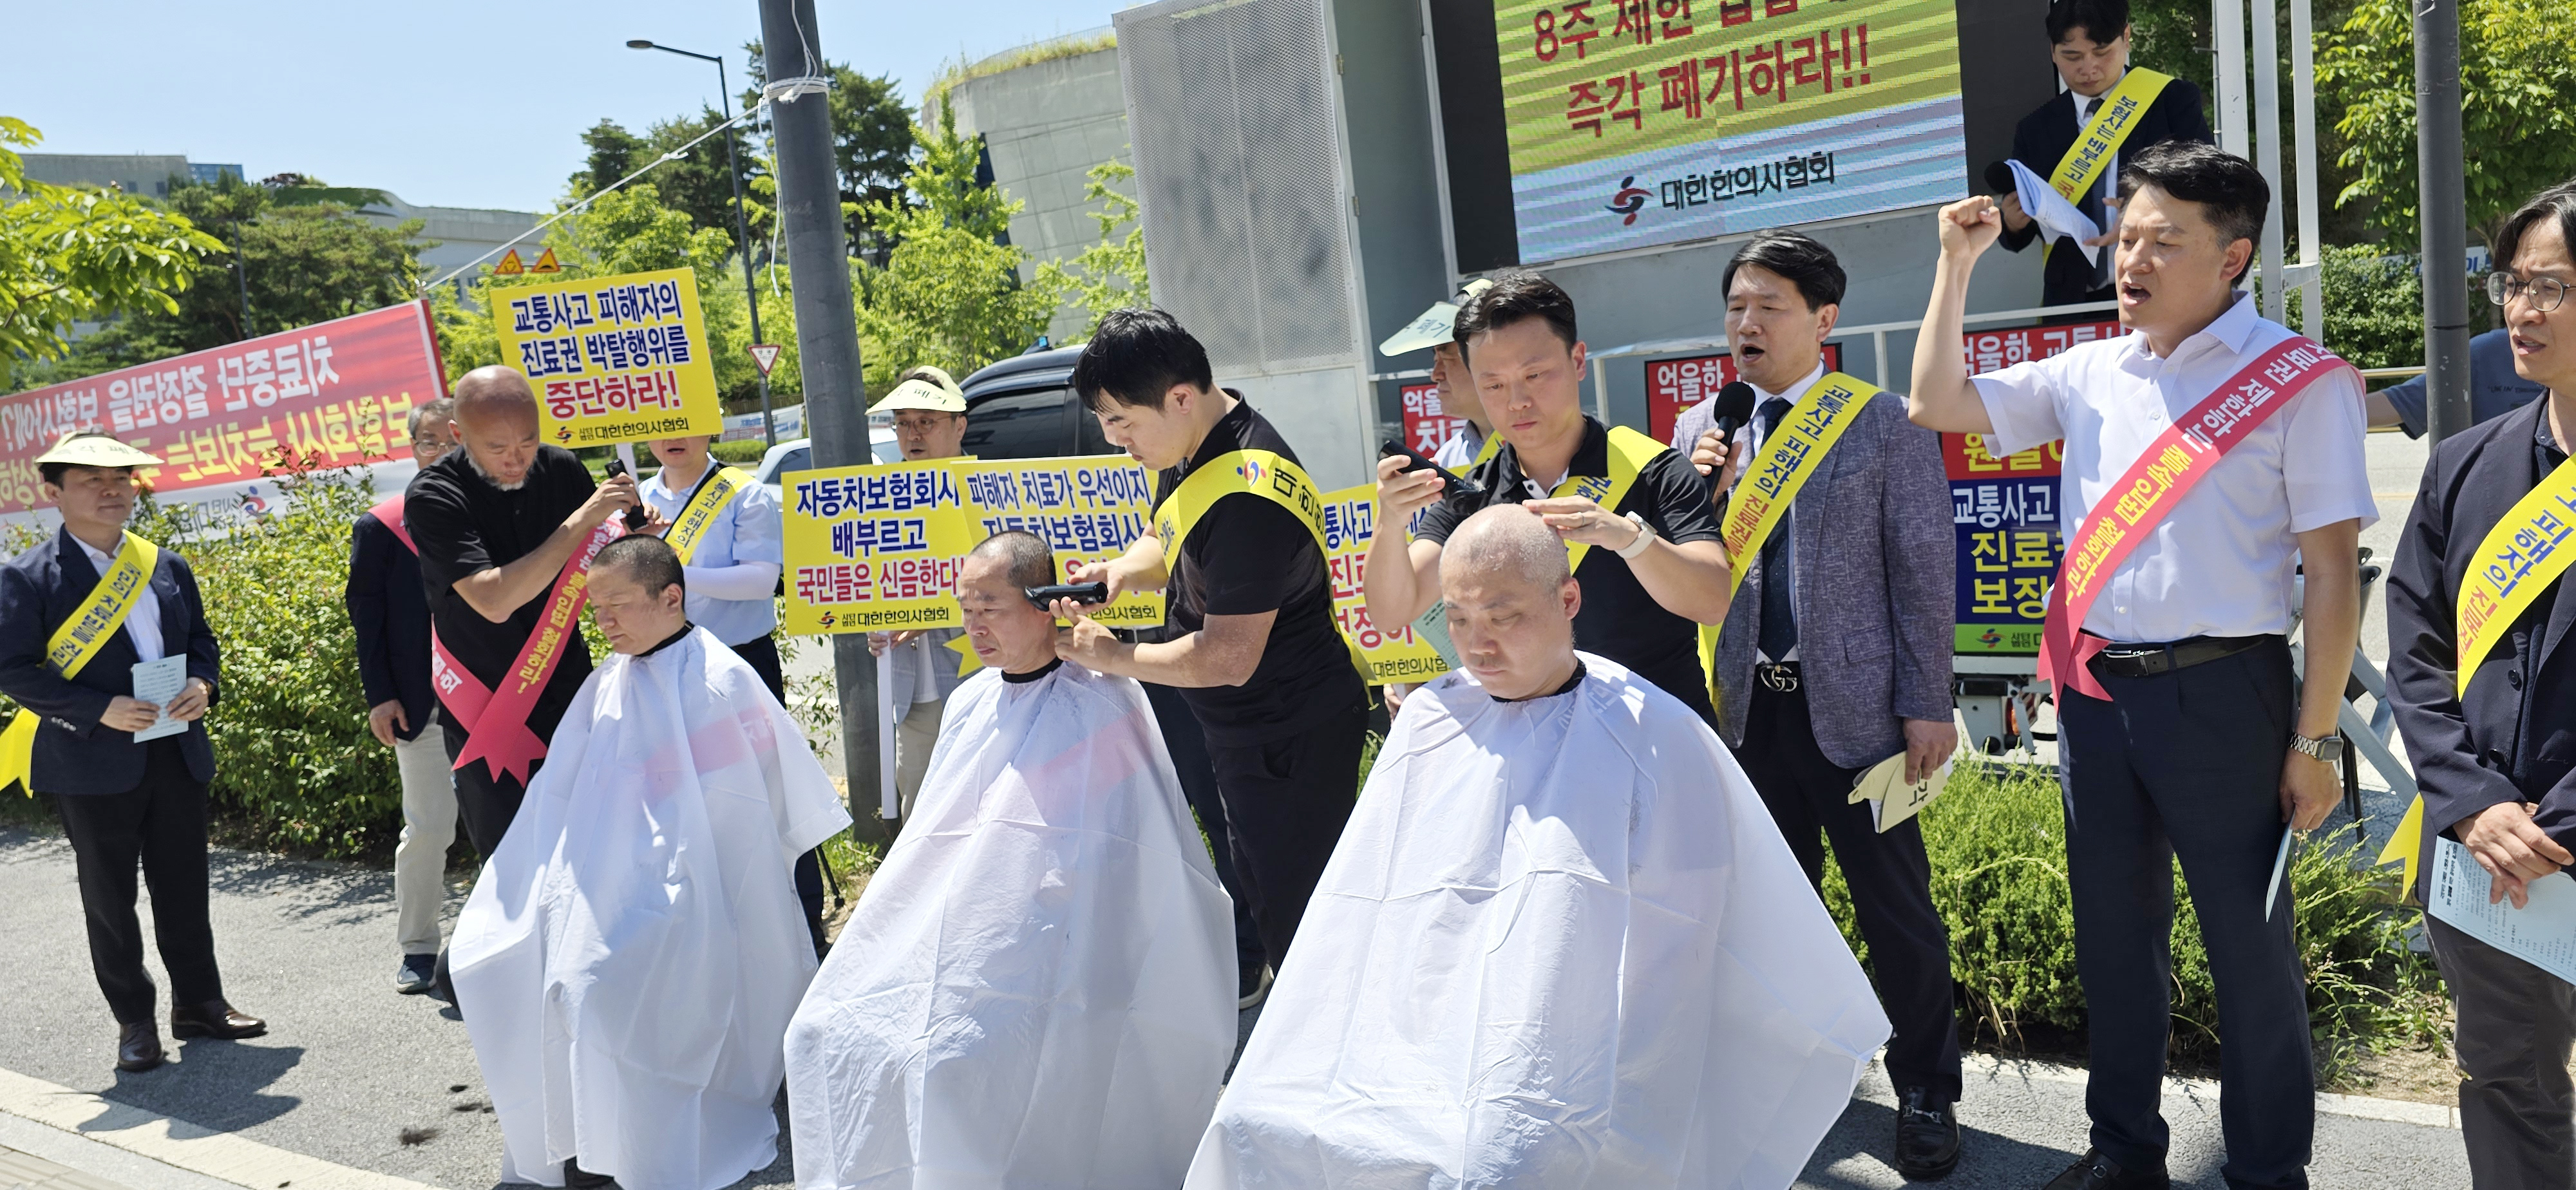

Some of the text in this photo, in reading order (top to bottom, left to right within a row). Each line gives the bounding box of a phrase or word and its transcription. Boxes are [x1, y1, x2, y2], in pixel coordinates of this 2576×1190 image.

[1534, 1, 1600, 62] 8주
[1566, 23, 1871, 138] 즉각 폐기하라!!
[2096, 95, 2138, 141] 보험사는
[1660, 151, 1835, 211] 대한한의사협회
[2063, 137, 2108, 184] 배부르고
[512, 281, 682, 333] 교통사고 피해자의
[520, 325, 689, 377] 진료권 박탈행위를
[547, 370, 680, 419] 중단하라!
[1795, 384, 1853, 441] 교통사고
[2181, 377, 2276, 454] 제한하는
[594, 417, 689, 440] 대한한의사협회
[967, 467, 1151, 510] 피해자 치료가 우선이지
[1754, 435, 1812, 500] 피해자의
[2114, 443, 2193, 527] 졸속입법
[797, 471, 960, 518] 자동차보험회사
[1953, 484, 2054, 529] 교통사고
[674, 508, 708, 548] 피해자의
[832, 519, 927, 558] 배부르고
[1971, 530, 2065, 572] 진료
[2065, 516, 2126, 606] 철회하라!
[2483, 509, 2575, 600] 피해자의
[797, 563, 872, 604] 국민들은
[1972, 575, 2050, 619] 보장
[857, 607, 949, 627] 대한한의사협회
[1087, 605, 1157, 620] 한의사협회
[517, 627, 562, 694] 철회하라!
[1373, 656, 1453, 677] 대한한의사협
